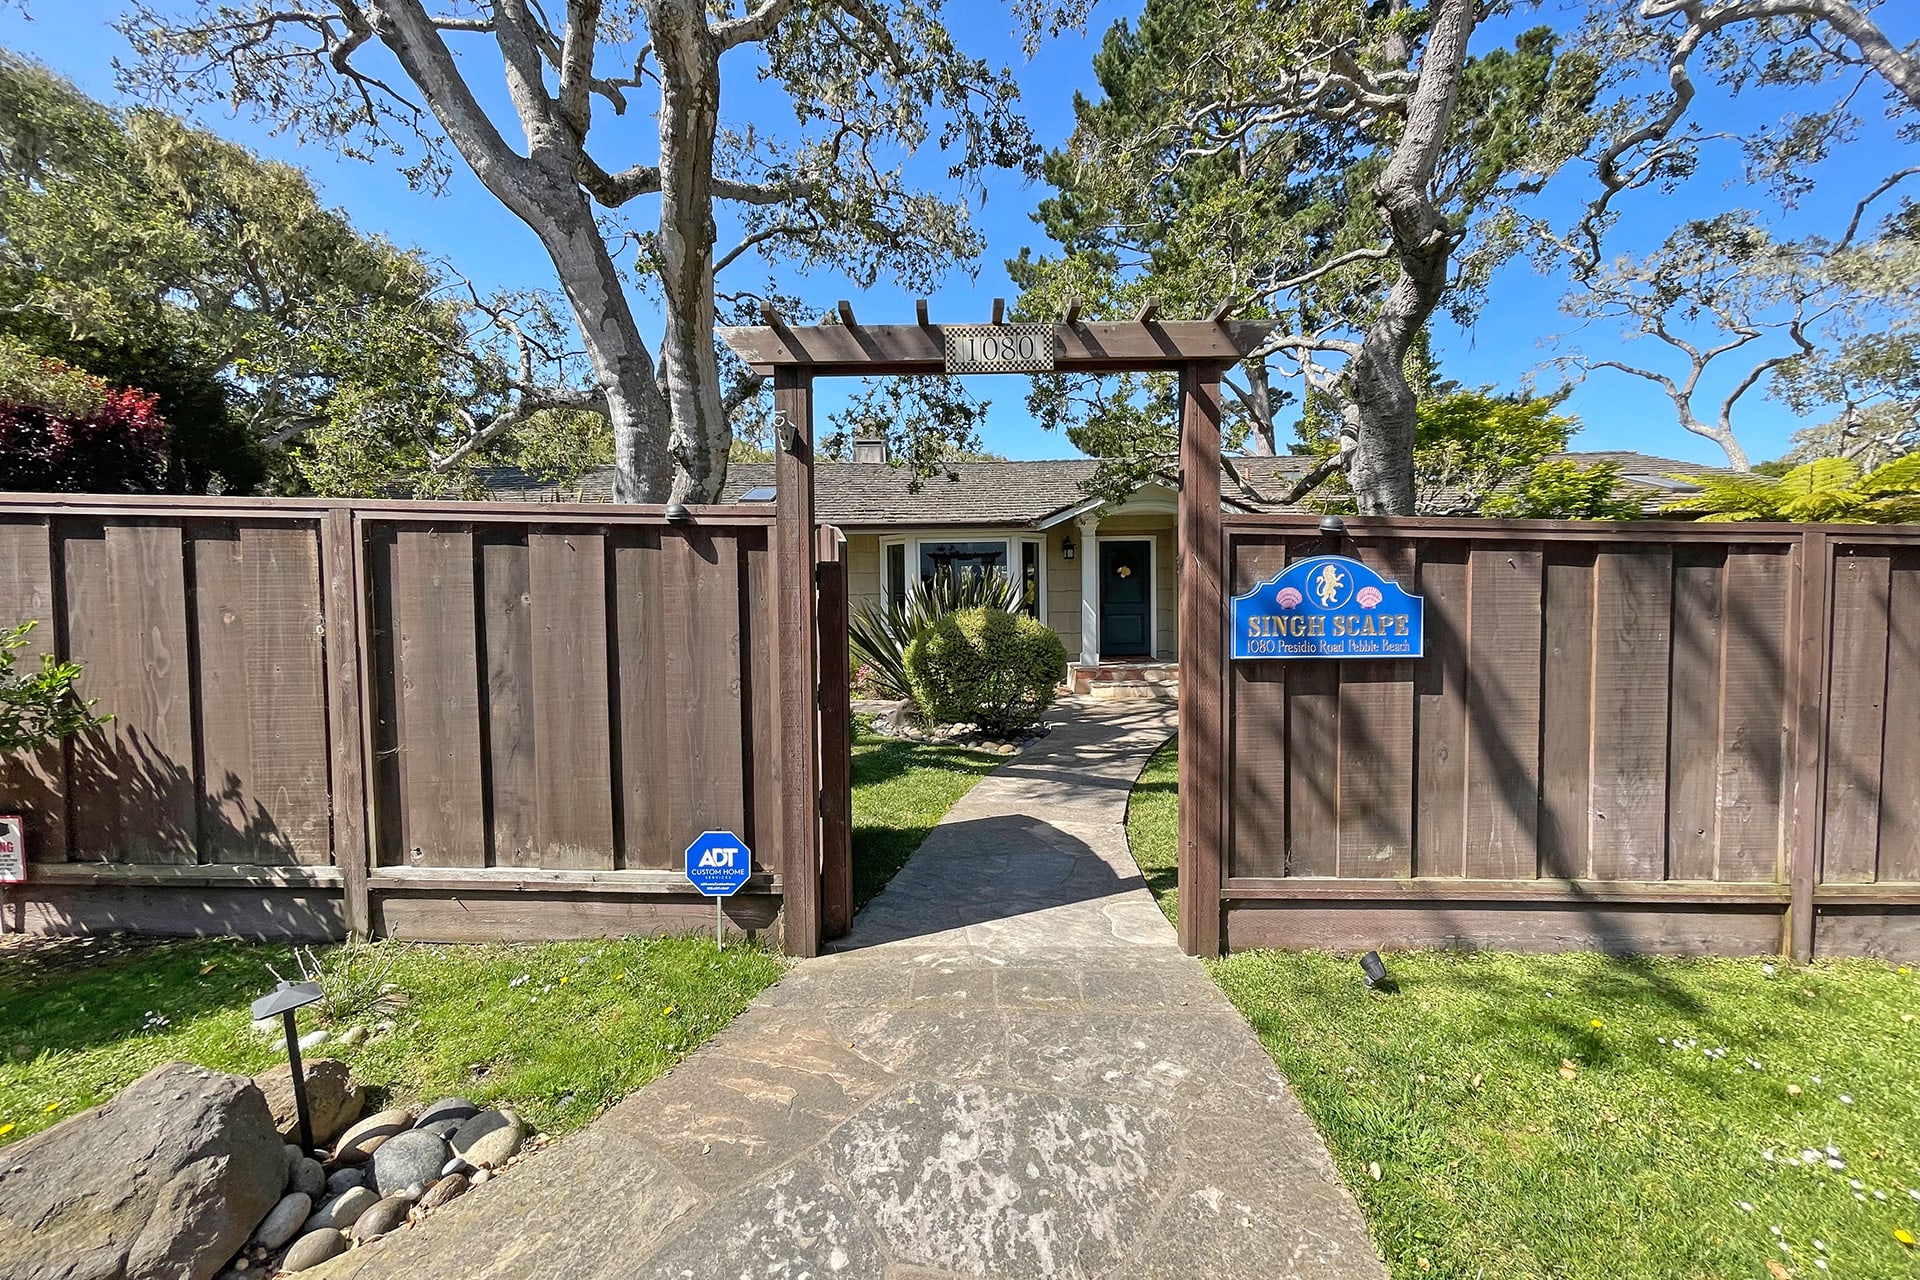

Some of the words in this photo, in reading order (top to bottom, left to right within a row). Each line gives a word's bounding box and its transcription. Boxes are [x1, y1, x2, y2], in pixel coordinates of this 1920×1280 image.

[968, 335, 1034, 362] 1080
[1248, 614, 1326, 637] SINGH
[1332, 614, 1409, 636] SCAPE
[1247, 639, 1275, 653] 1080
[1278, 639, 1317, 653] Presidio
[1319, 639, 1345, 655] Road
[1348, 639, 1379, 653] Pebble
[1382, 639, 1410, 652] Beach
[698, 847, 739, 868] ADT
[691, 868, 722, 876] CUSTOM
[723, 868, 745, 876] HOME
